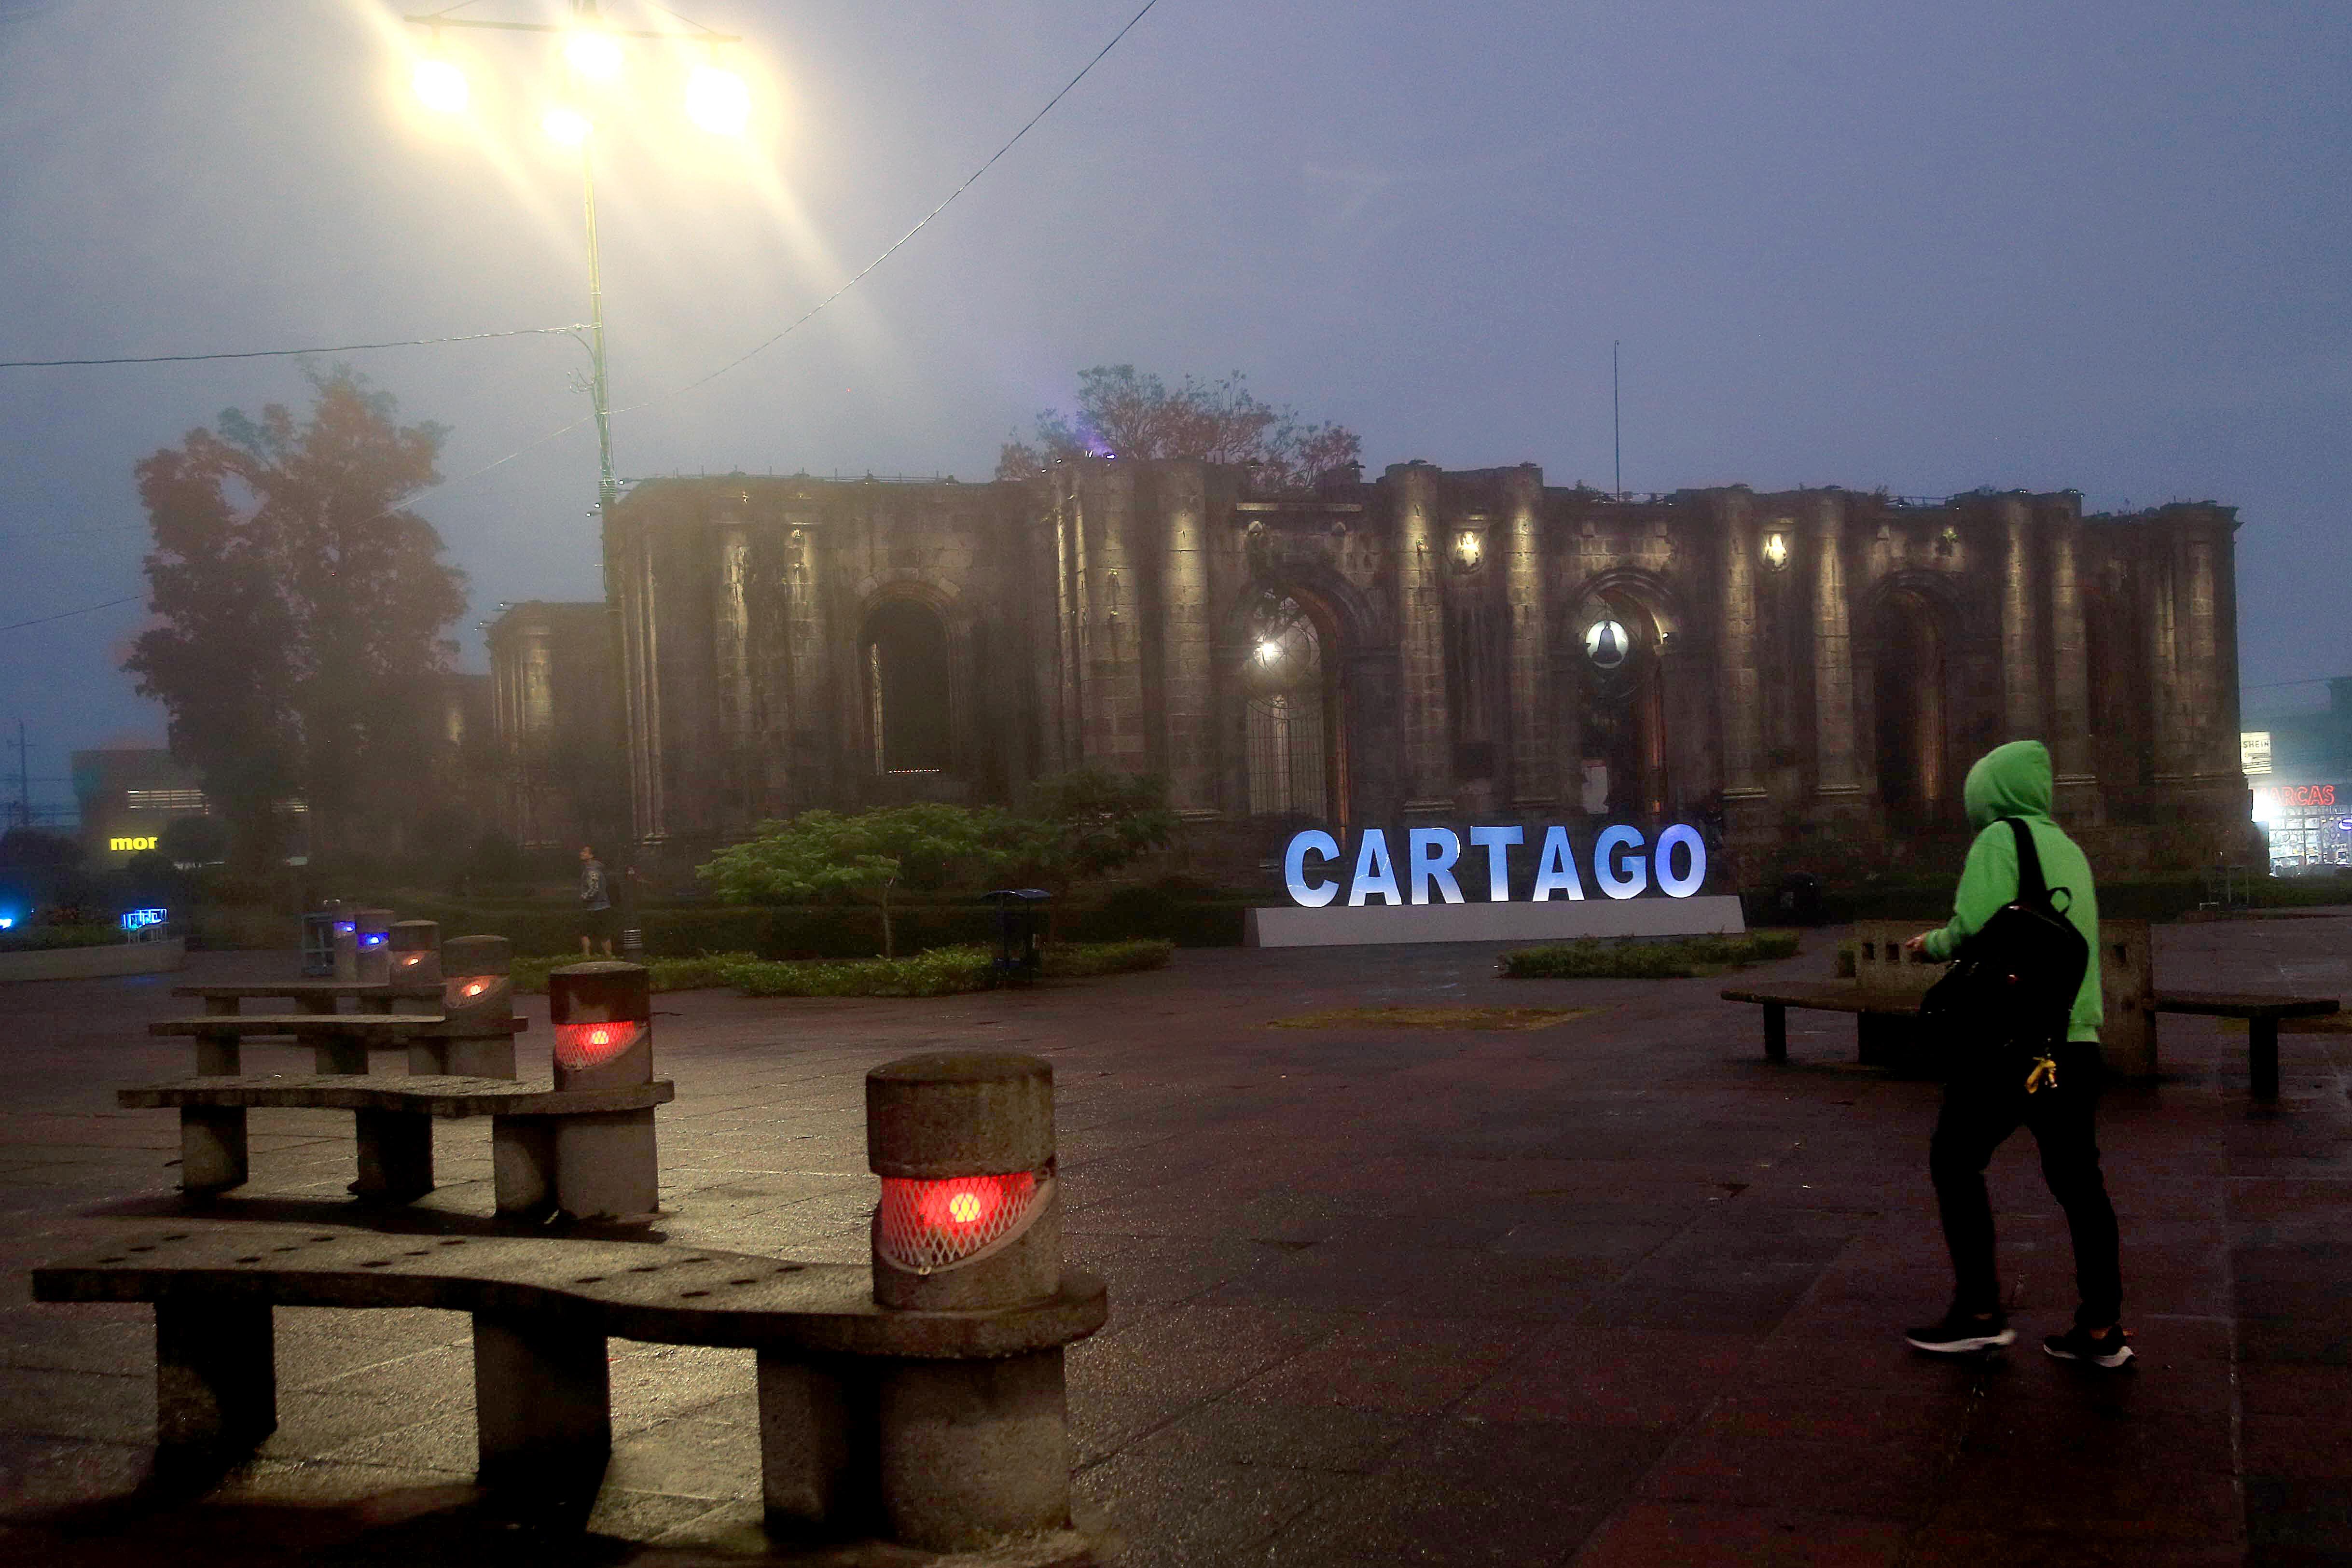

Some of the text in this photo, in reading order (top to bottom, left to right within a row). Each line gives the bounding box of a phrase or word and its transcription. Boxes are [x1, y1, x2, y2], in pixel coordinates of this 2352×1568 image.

[2243, 740, 2269, 749] SHEIN
[111, 837, 158, 851] mor
[1285, 824, 1706, 907] CARTAGO
